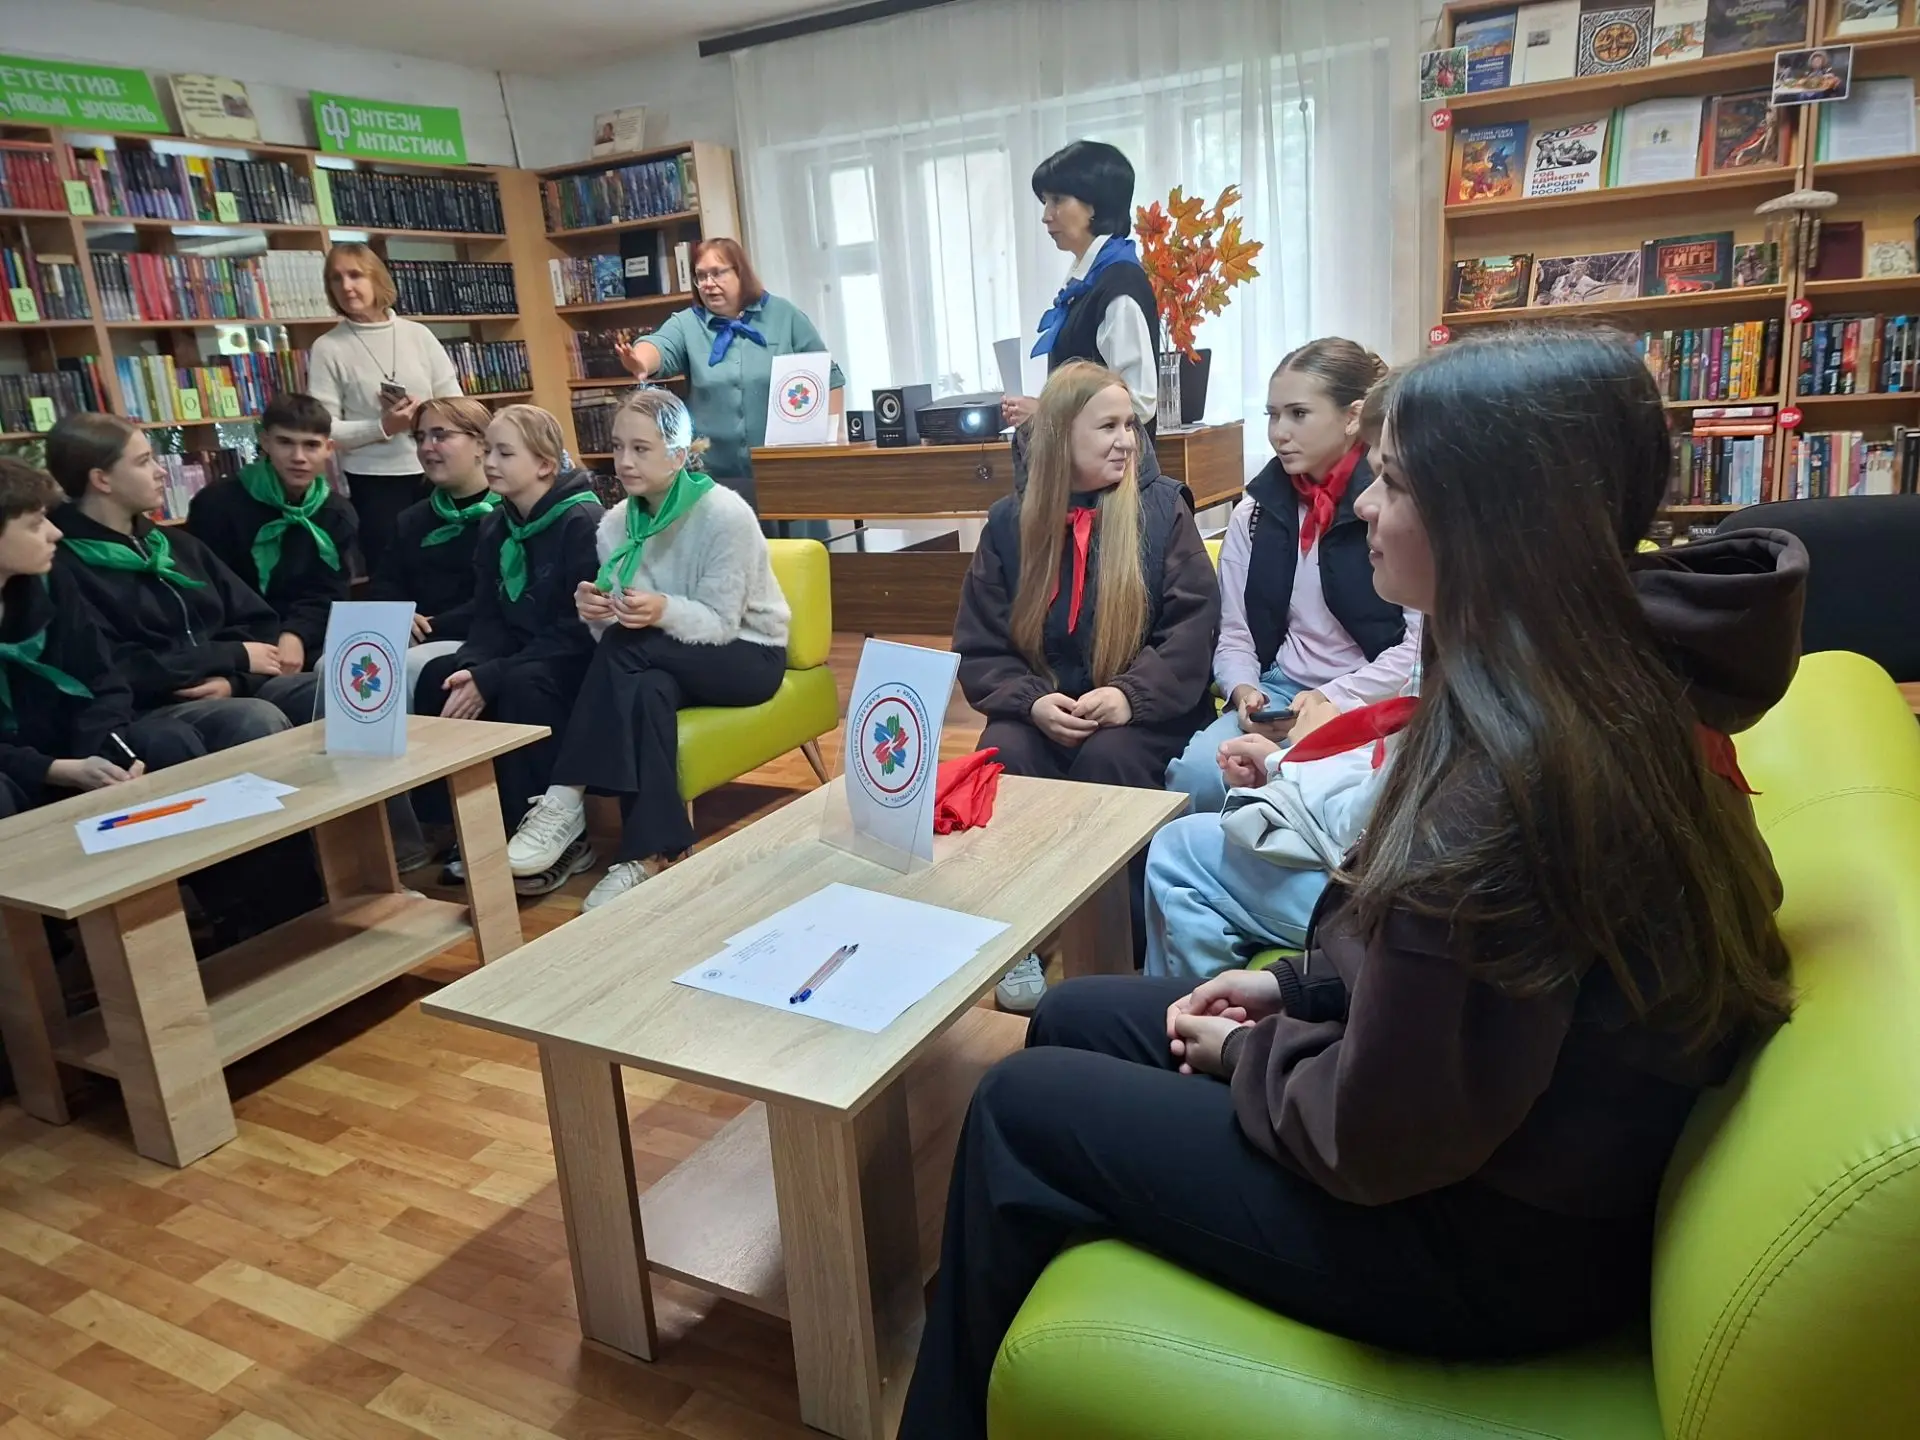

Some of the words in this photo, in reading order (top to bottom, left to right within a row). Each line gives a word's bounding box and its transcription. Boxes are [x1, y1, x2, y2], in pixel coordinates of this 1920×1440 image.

[76, 97, 158, 124] УРОВЕНЬ
[350, 107, 423, 133] ЭНТЕЗИ
[1431, 113, 1450, 128] 12+
[1541, 122, 1598, 140] 2026
[357, 131, 457, 157] АНТАСТИКА
[1531, 185, 1577, 196] РОССИИ
[1532, 178, 1584, 190] НАРОДОВ
[1663, 250, 1712, 268] ТИГР
[1430, 329, 1448, 342] 16+
